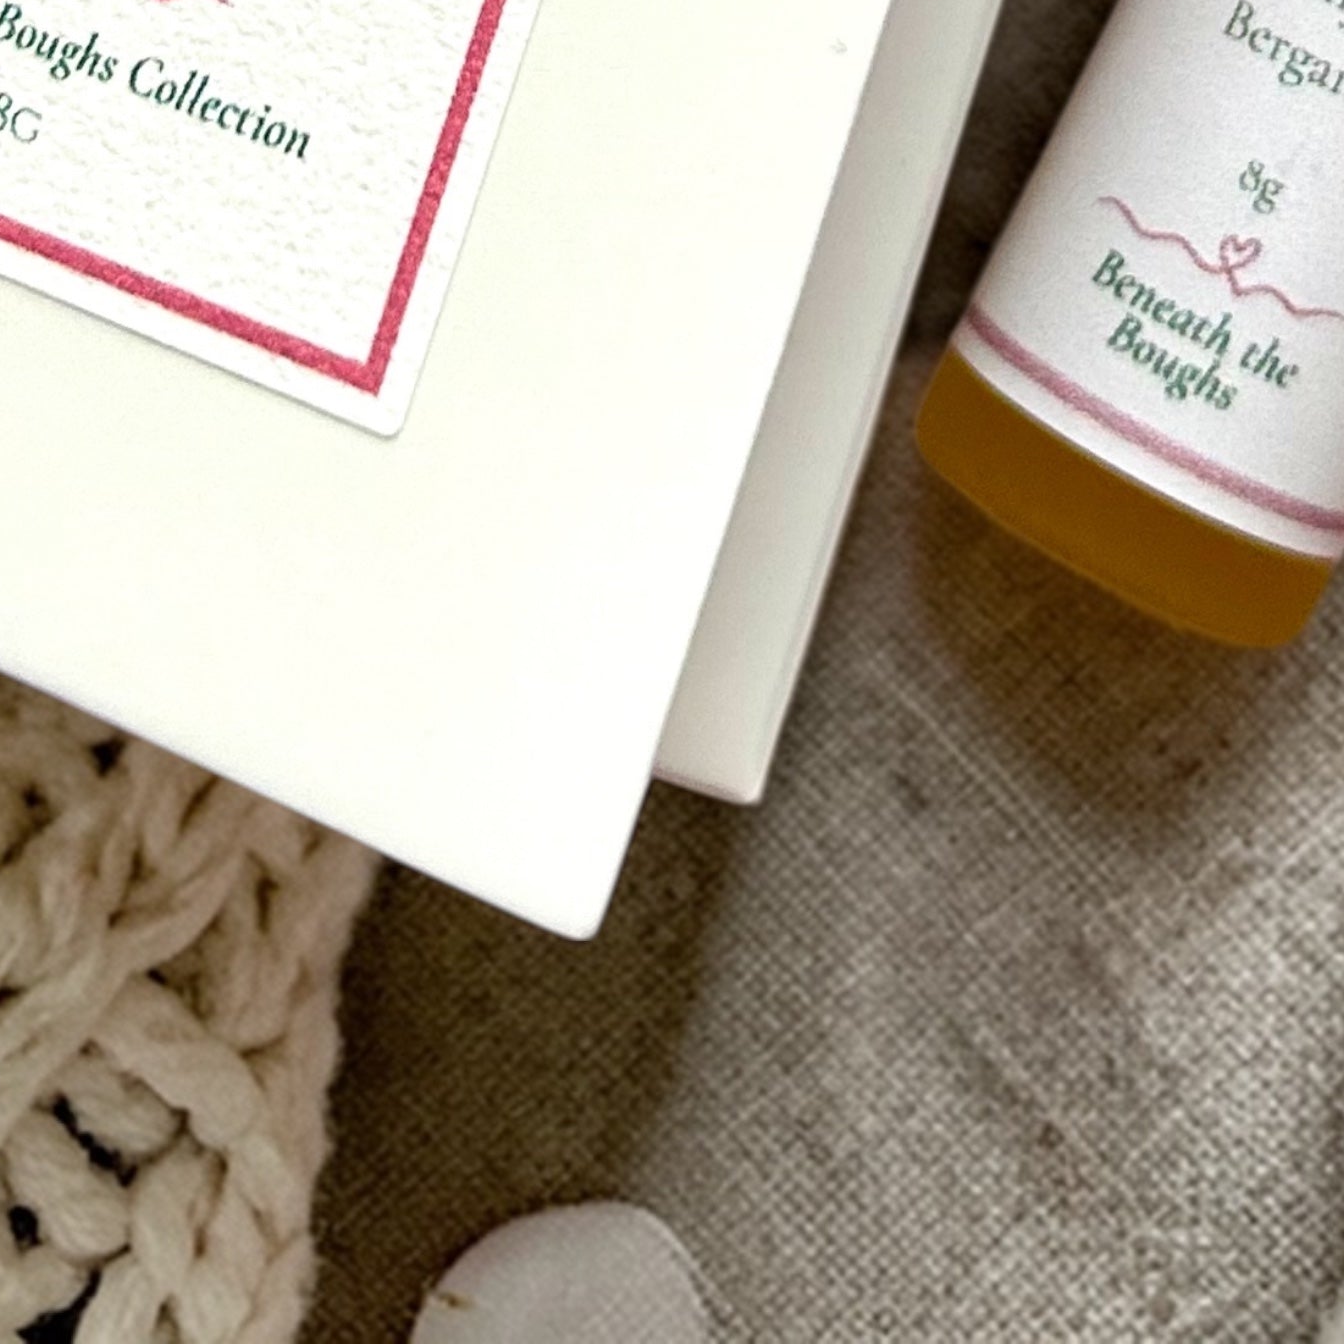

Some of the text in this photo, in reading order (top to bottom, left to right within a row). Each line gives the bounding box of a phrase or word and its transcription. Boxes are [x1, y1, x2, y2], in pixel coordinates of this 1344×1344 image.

[129, 55, 313, 158] Collection
[1238, 159, 1286, 214] 8g
[1091, 249, 1301, 389] Beneath the
[1106, 314, 1239, 411] Boughs
